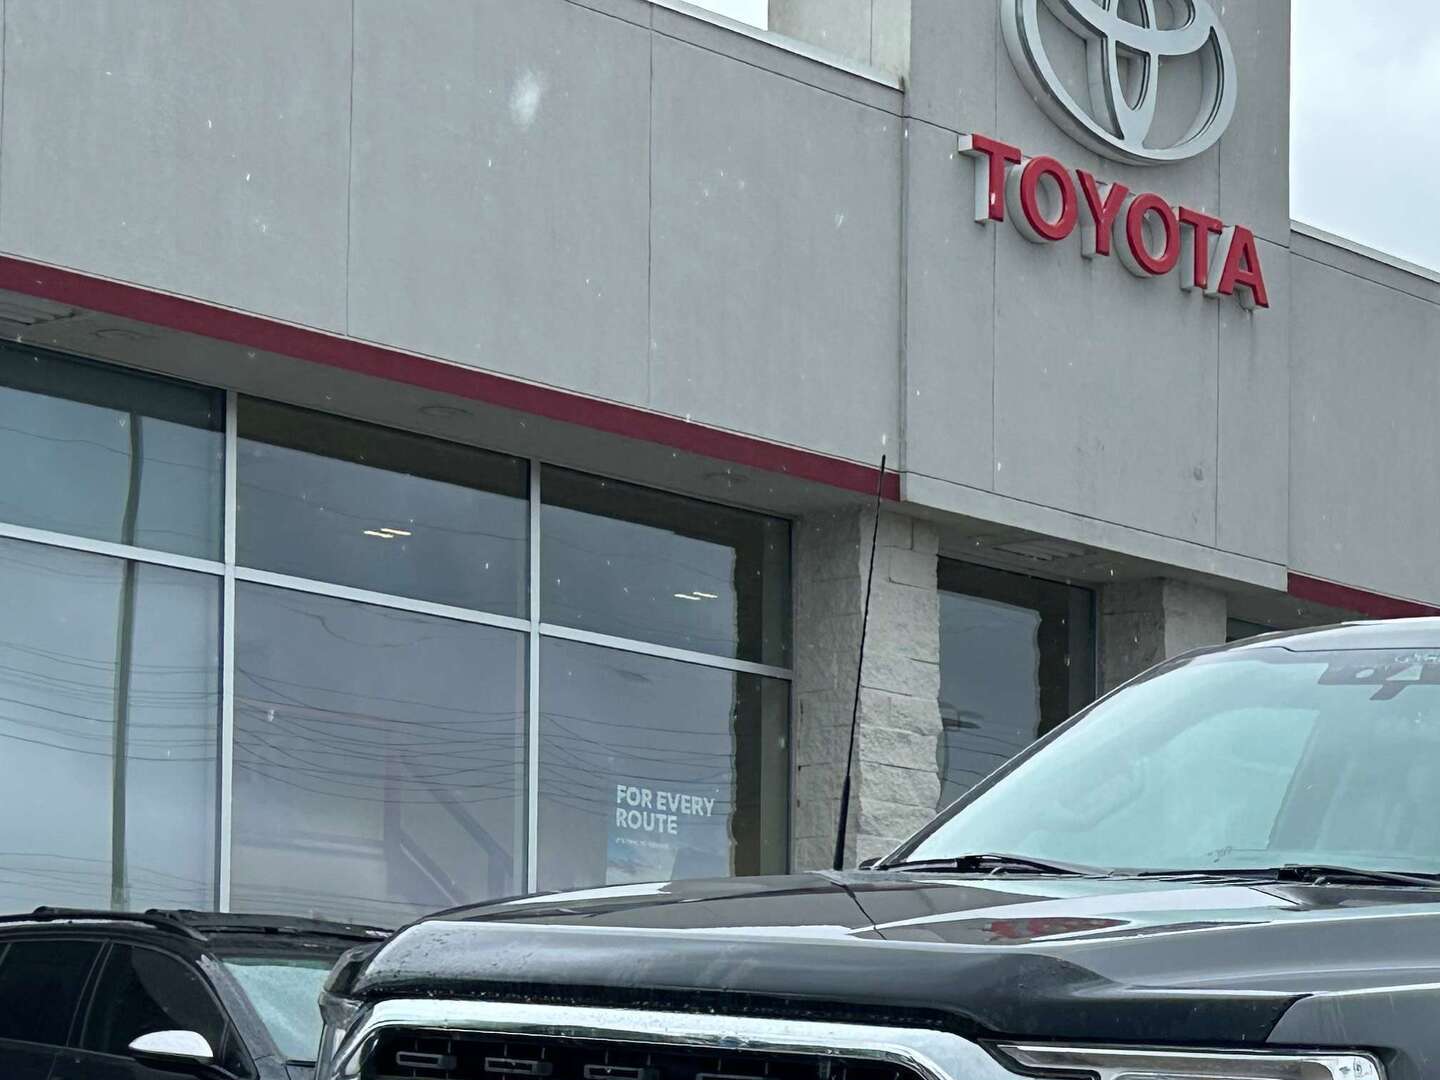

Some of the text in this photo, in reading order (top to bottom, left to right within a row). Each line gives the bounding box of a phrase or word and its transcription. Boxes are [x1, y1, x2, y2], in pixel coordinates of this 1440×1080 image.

[968, 133, 1270, 309] TOYOTA
[616, 784, 715, 817] FOR EVERY
[616, 809, 678, 834] ROUTE
